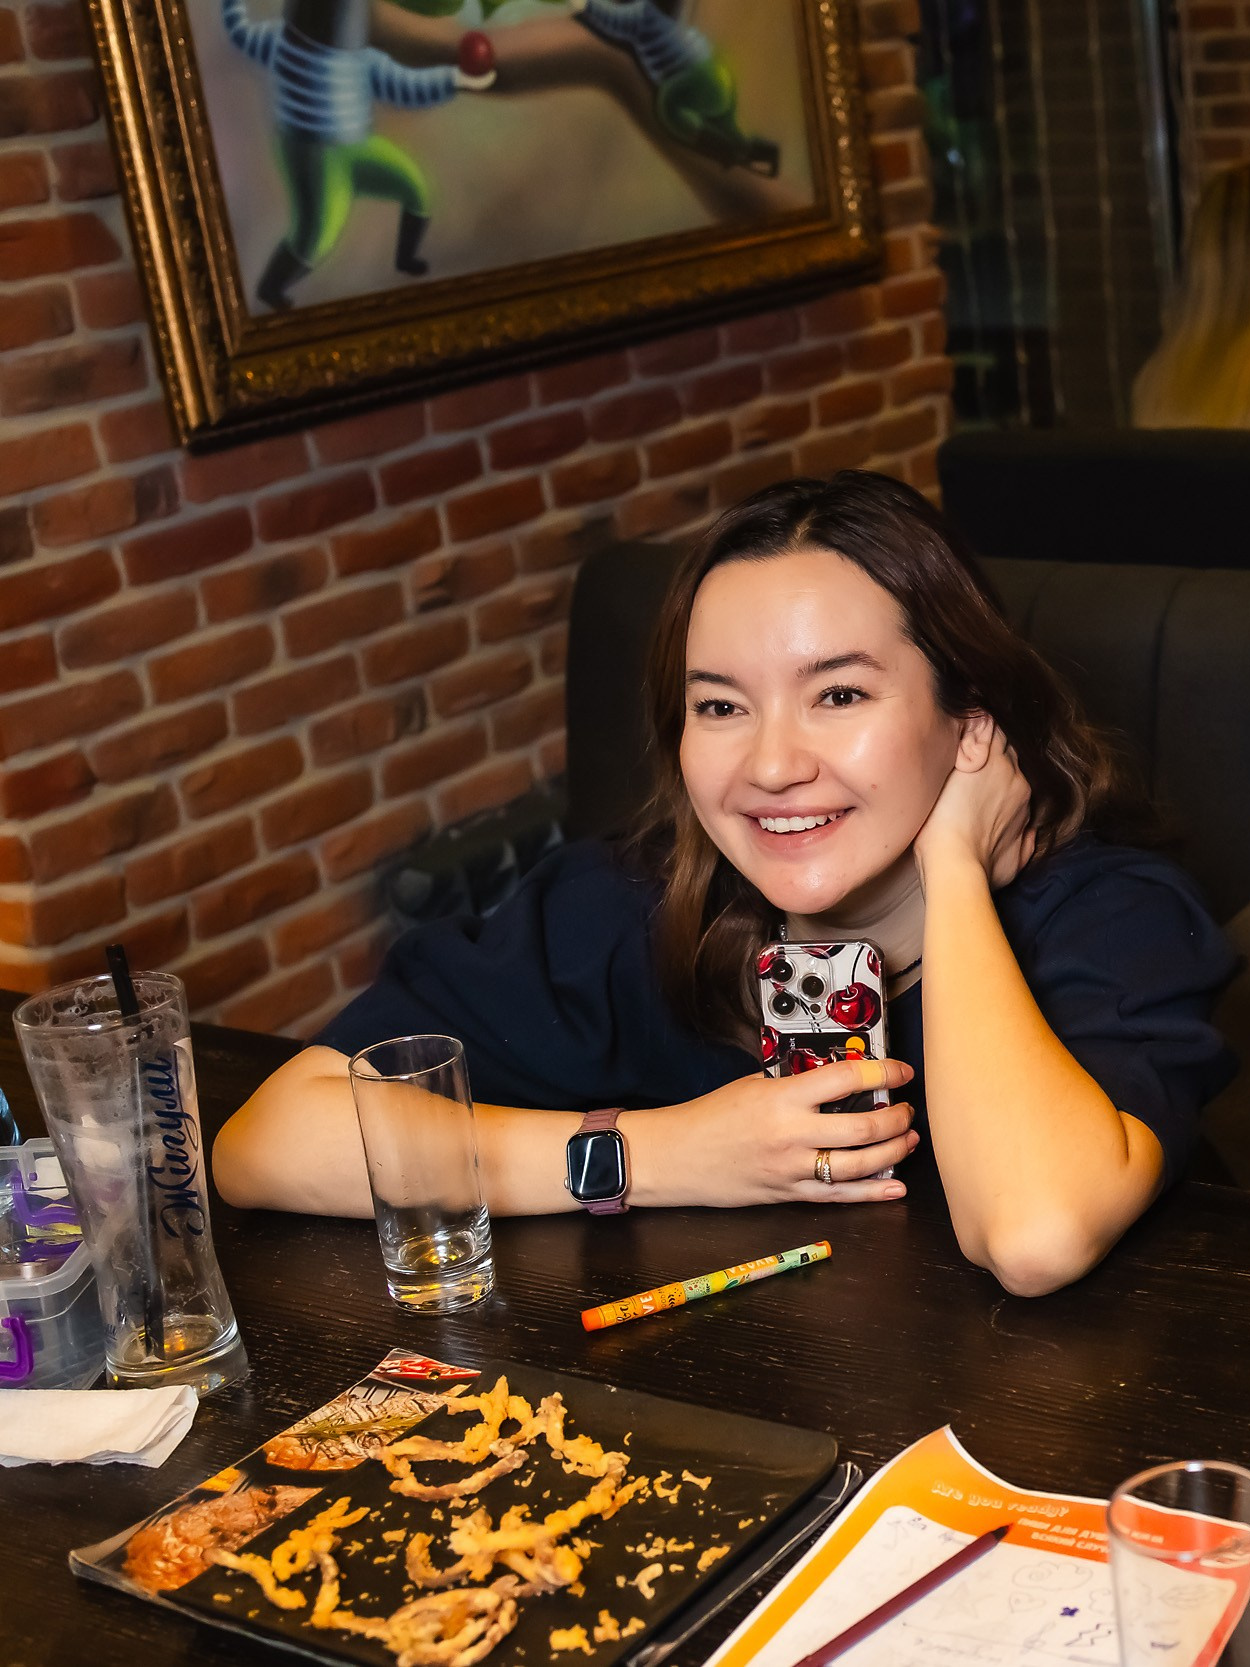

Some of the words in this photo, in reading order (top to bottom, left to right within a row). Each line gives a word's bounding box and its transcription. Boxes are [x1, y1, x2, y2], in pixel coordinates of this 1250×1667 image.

[145, 1050, 206, 1238] Жигули
[931, 1480, 964, 1501] Are
[968, 1493, 1003, 1510] you
